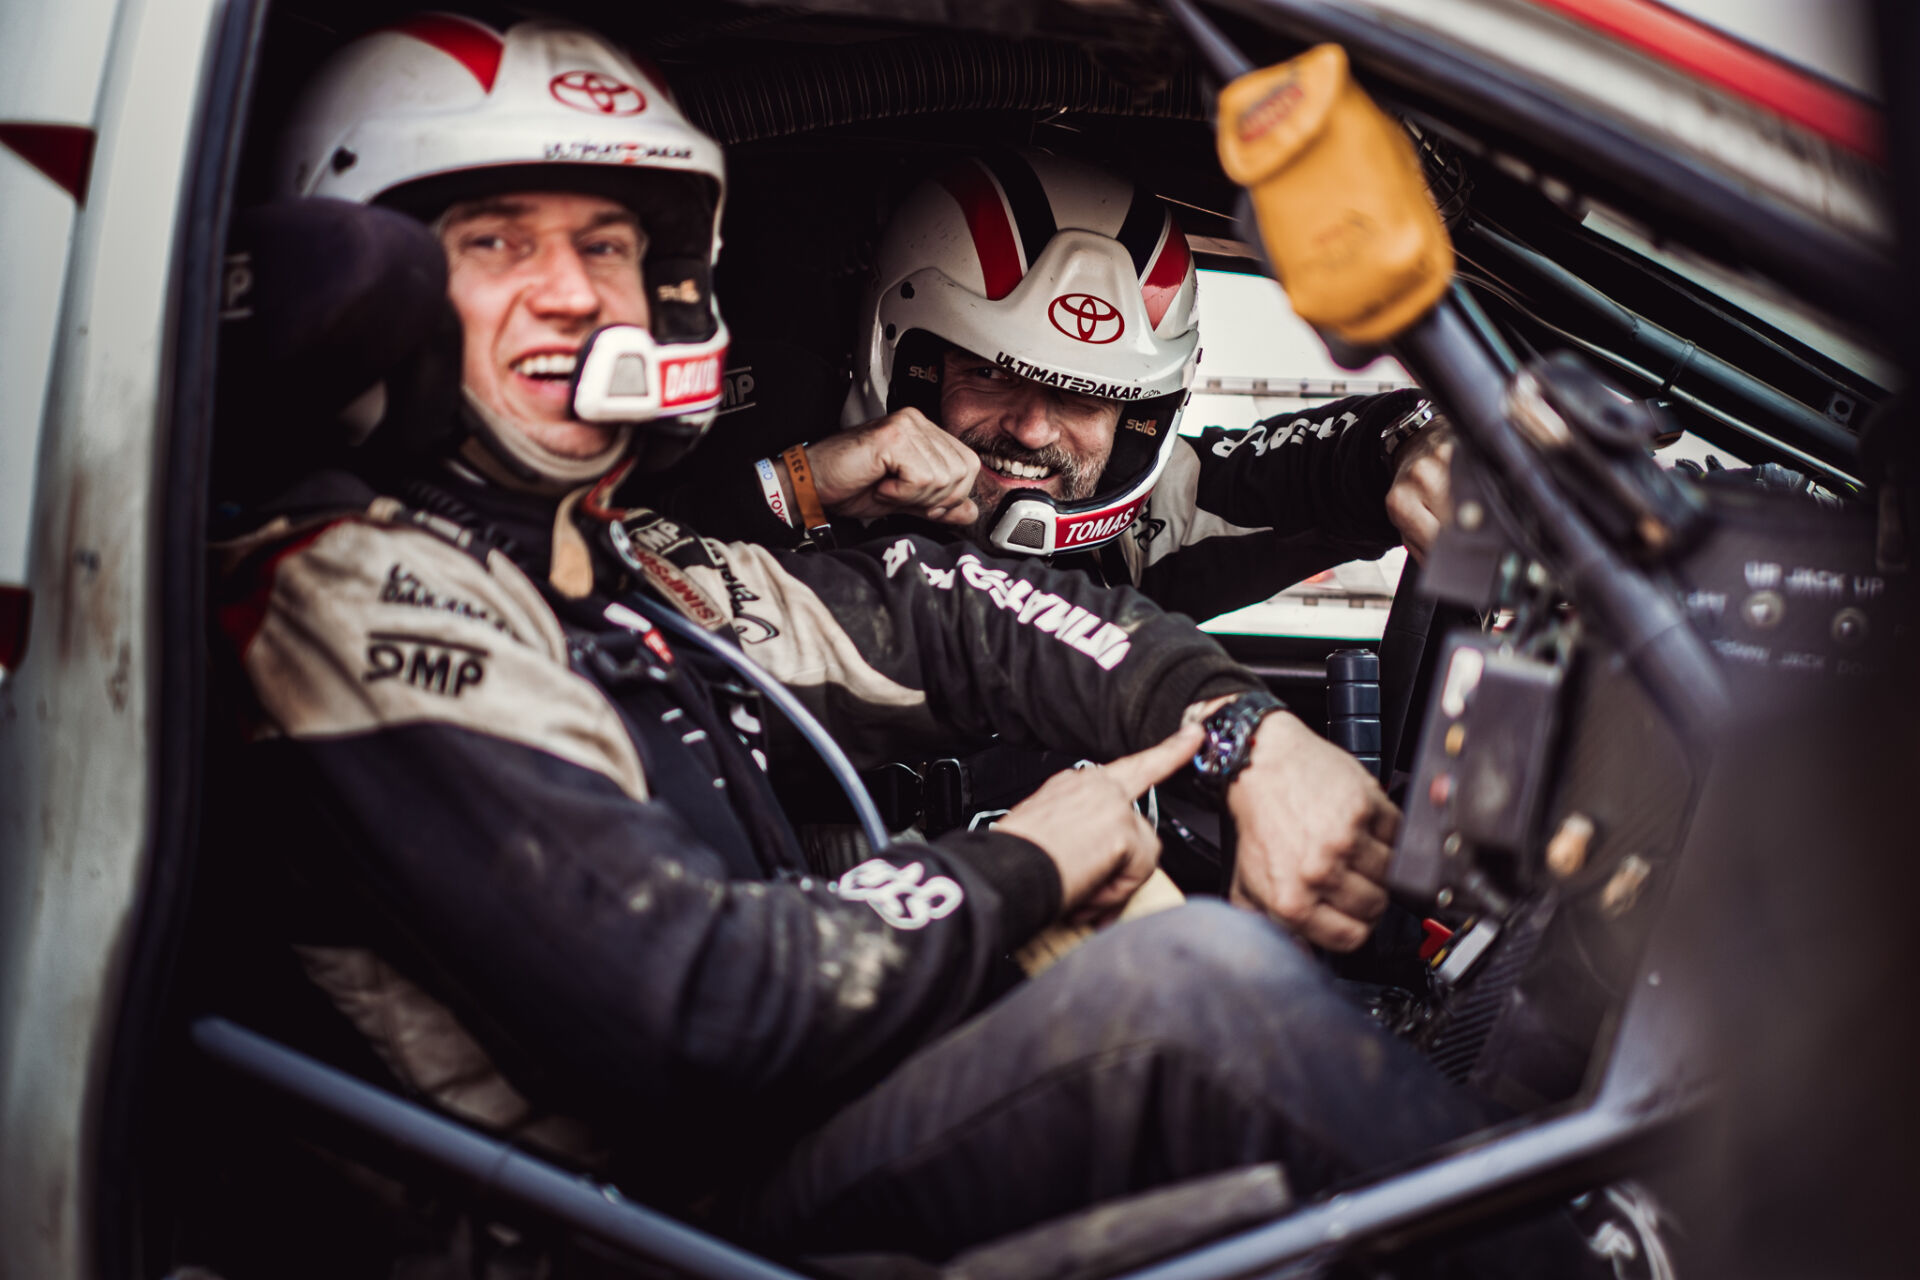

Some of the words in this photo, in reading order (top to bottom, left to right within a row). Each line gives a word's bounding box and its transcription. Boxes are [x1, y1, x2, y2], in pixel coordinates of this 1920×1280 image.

[1125, 418, 1157, 436] stilo
[1064, 507, 1135, 543] TOMAS
[1854, 575, 1885, 596] UP
